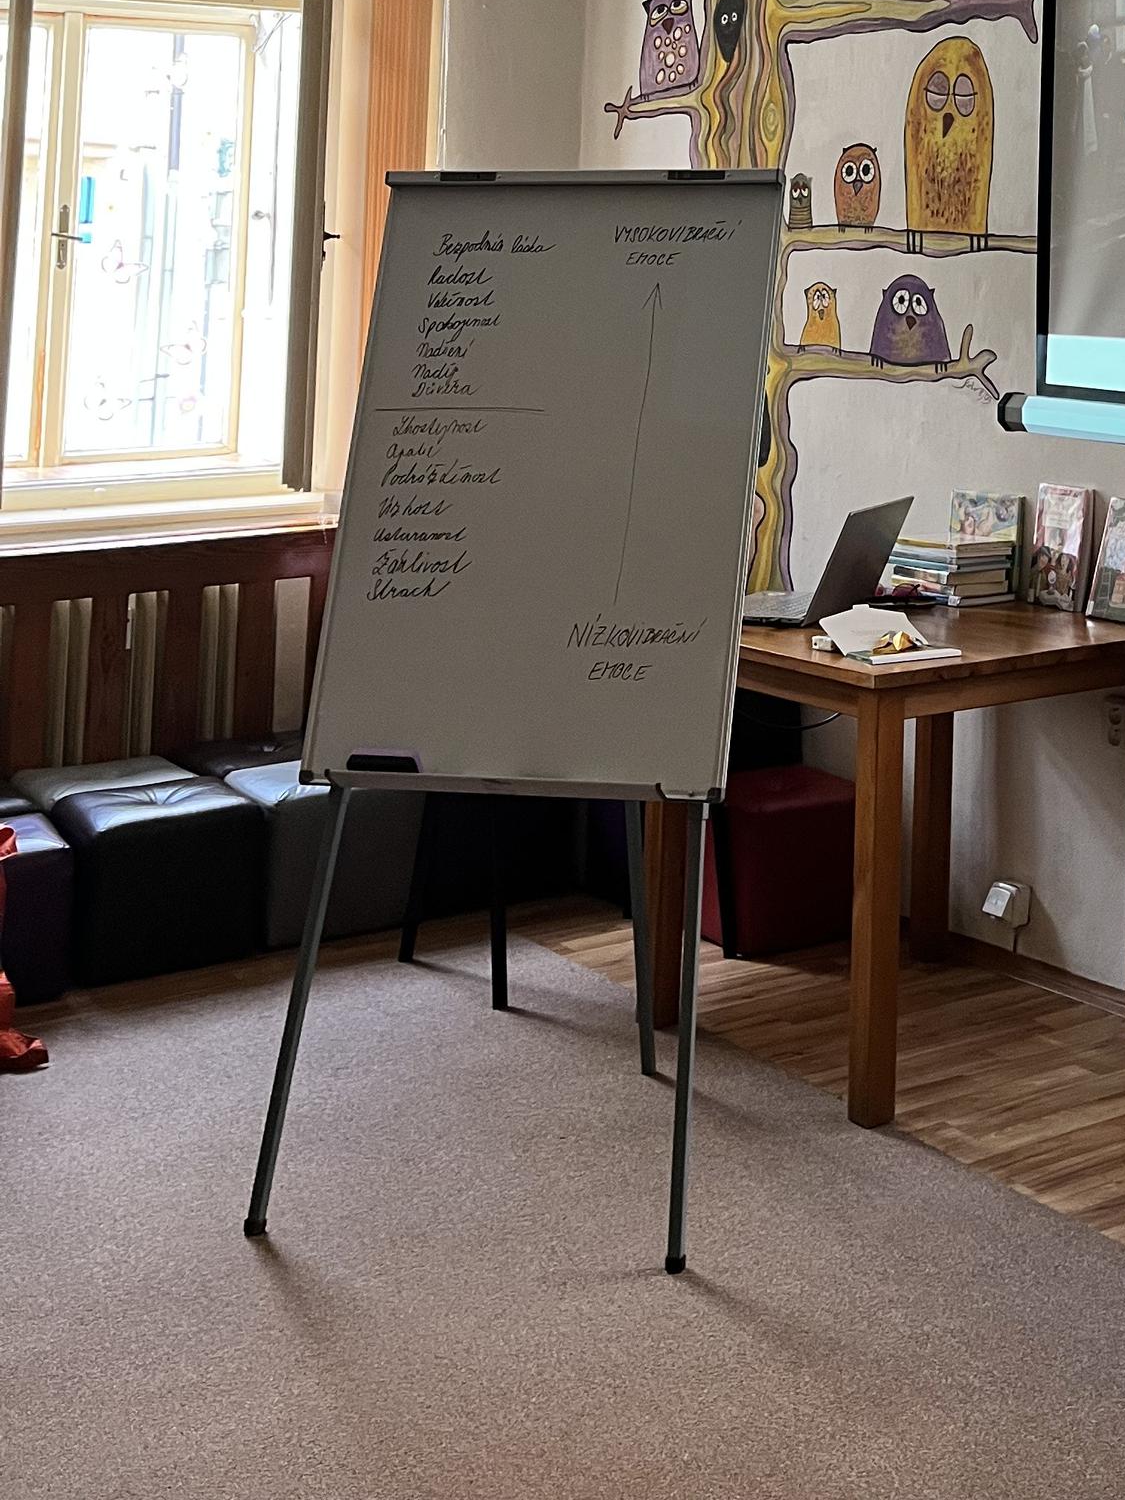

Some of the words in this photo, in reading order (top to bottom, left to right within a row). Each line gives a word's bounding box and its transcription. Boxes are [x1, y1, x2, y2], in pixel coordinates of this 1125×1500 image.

[626, 251, 682, 266] EMOCE
[427, 265, 493, 285] Radost
[366, 577, 452, 601] Strach
[587, 661, 653, 681] EMOCE
